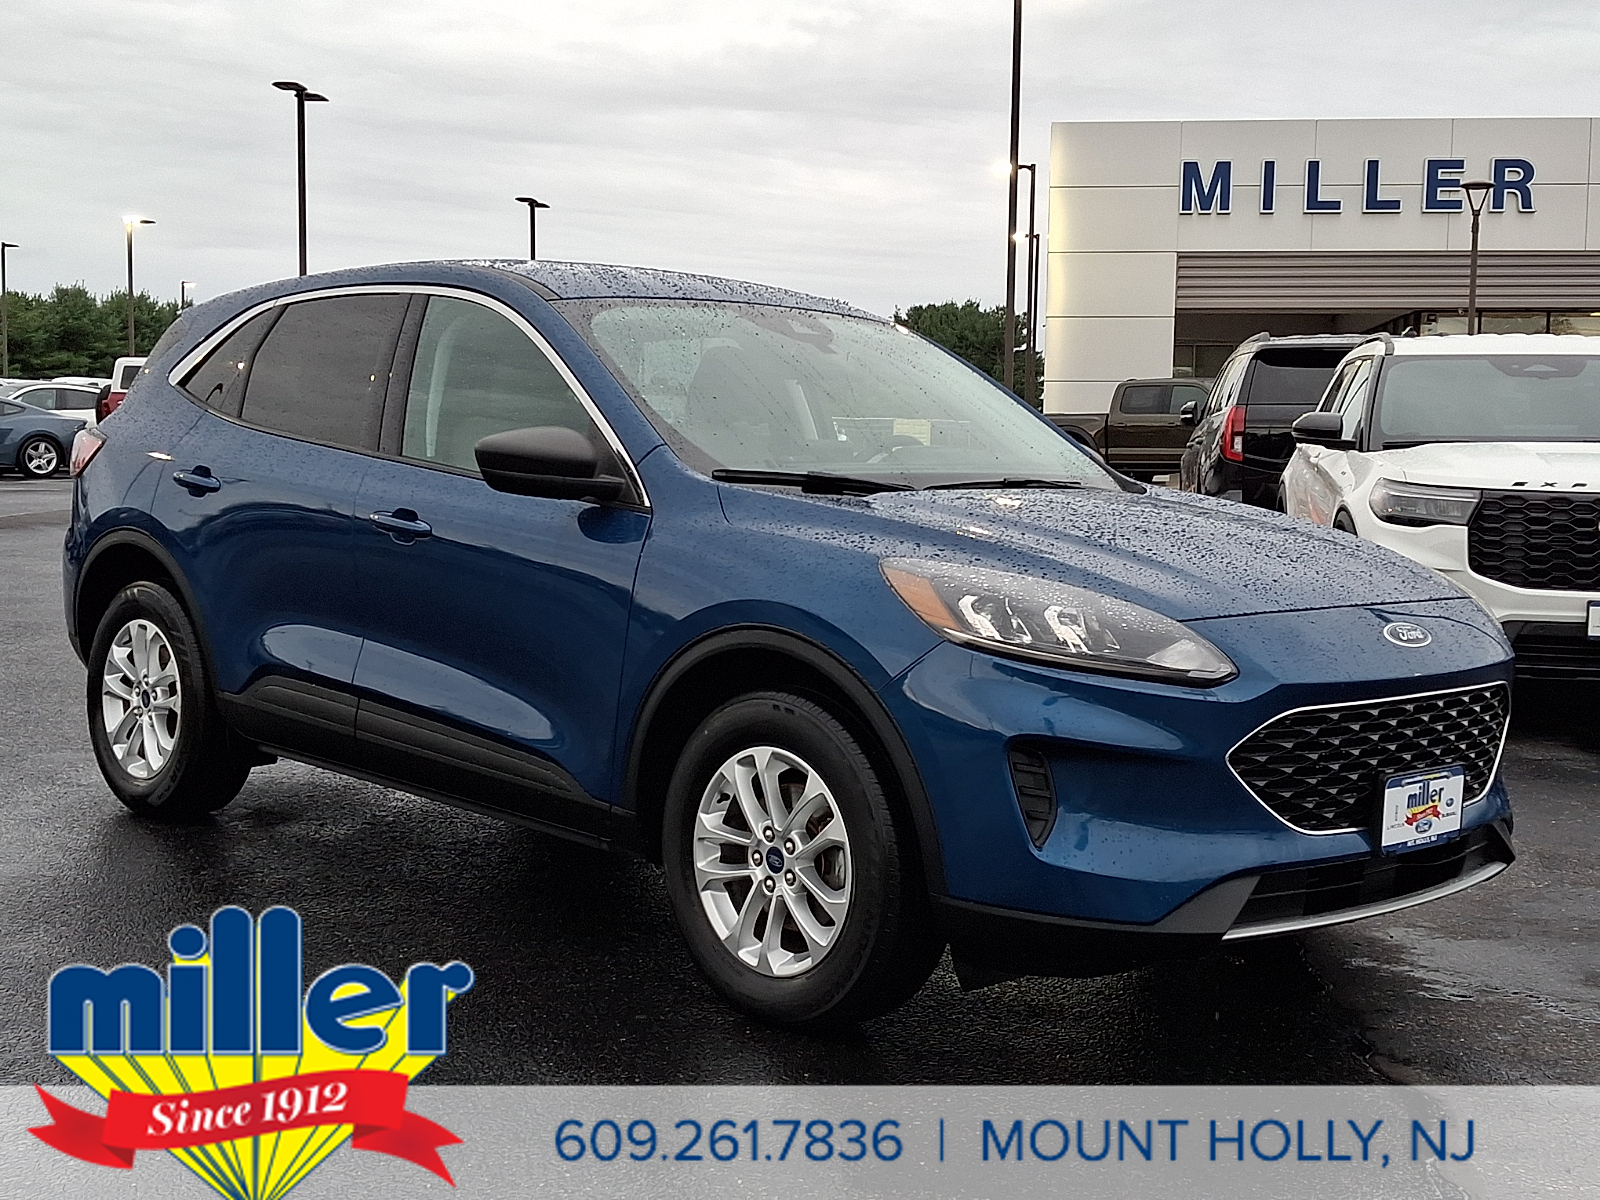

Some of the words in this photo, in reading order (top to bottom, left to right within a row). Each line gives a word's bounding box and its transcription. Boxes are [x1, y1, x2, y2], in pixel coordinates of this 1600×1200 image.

[1181, 159, 1535, 213] MILLER
[1395, 625, 1425, 641] Ford
[1406, 780, 1444, 810] miller
